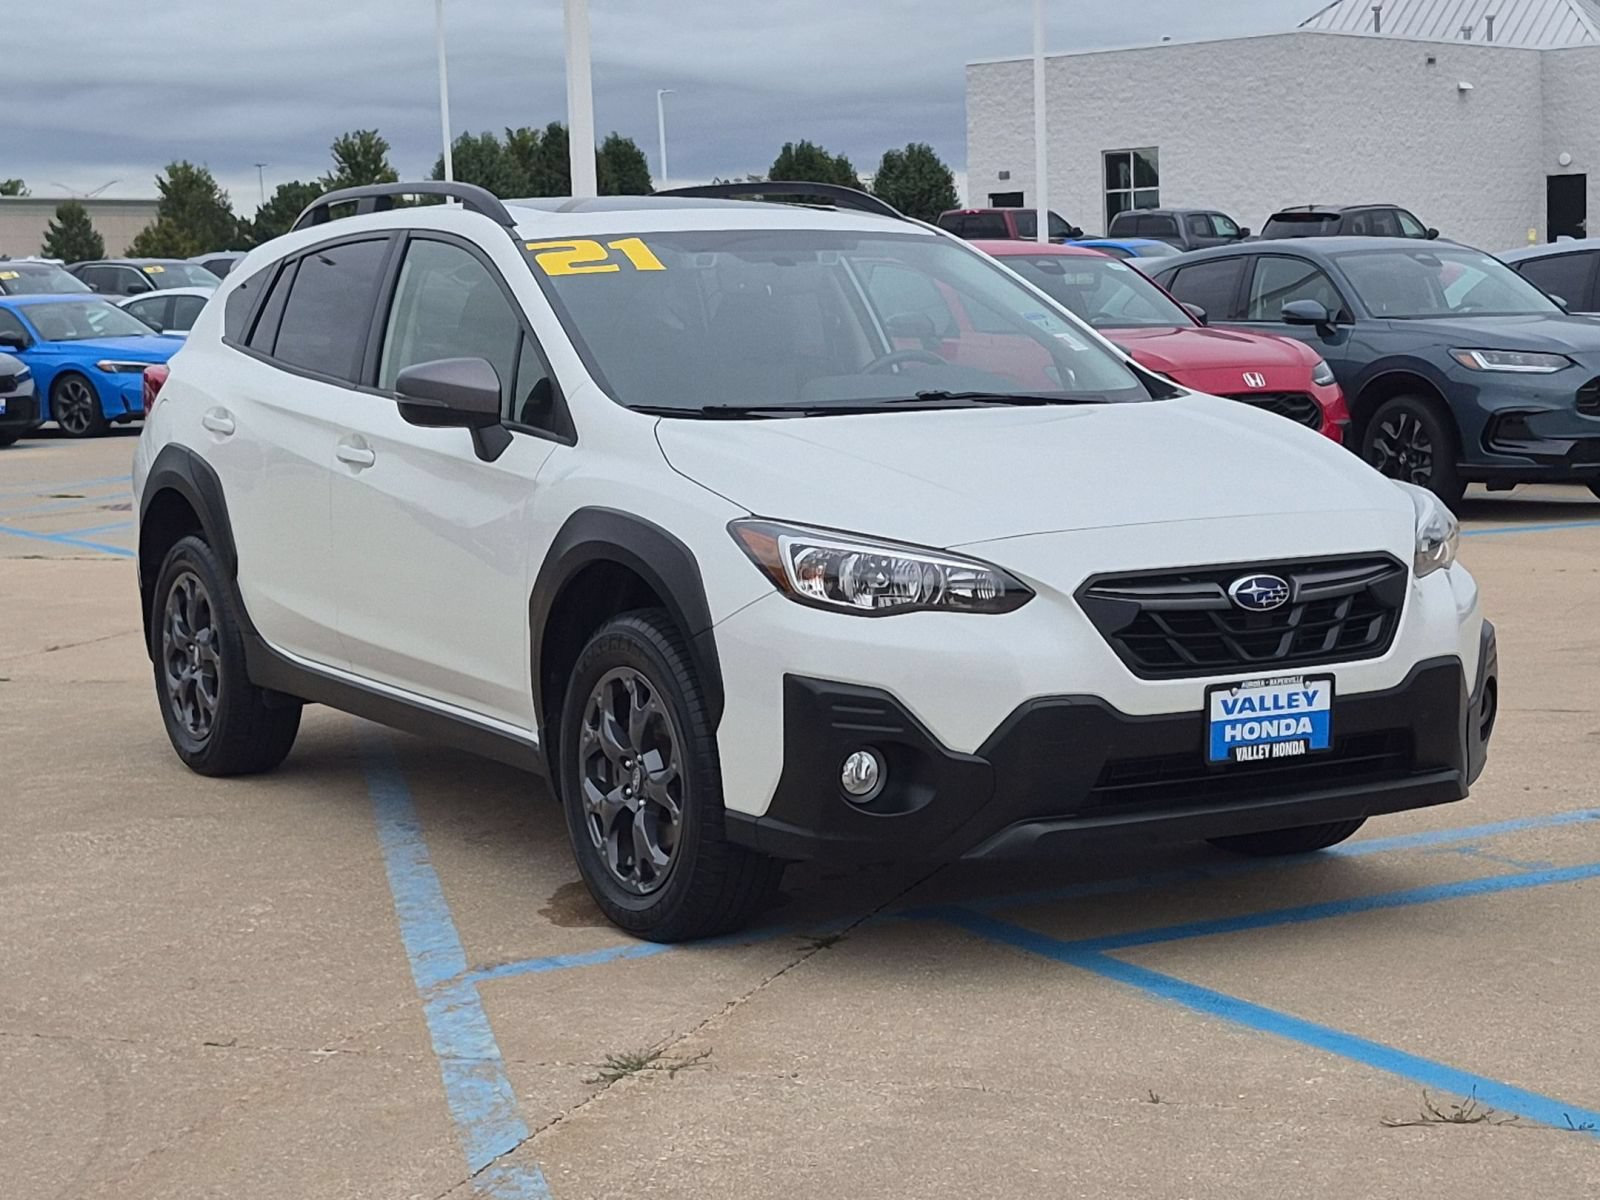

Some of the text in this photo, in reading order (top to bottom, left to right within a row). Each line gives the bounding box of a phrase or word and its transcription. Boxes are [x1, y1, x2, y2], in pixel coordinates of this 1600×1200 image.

[525, 237, 667, 276] 21
[1220, 689, 1319, 715] VALLEY
[1224, 717, 1312, 742] HONDA
[1236, 740, 1305, 762] VALLEY HONDA
